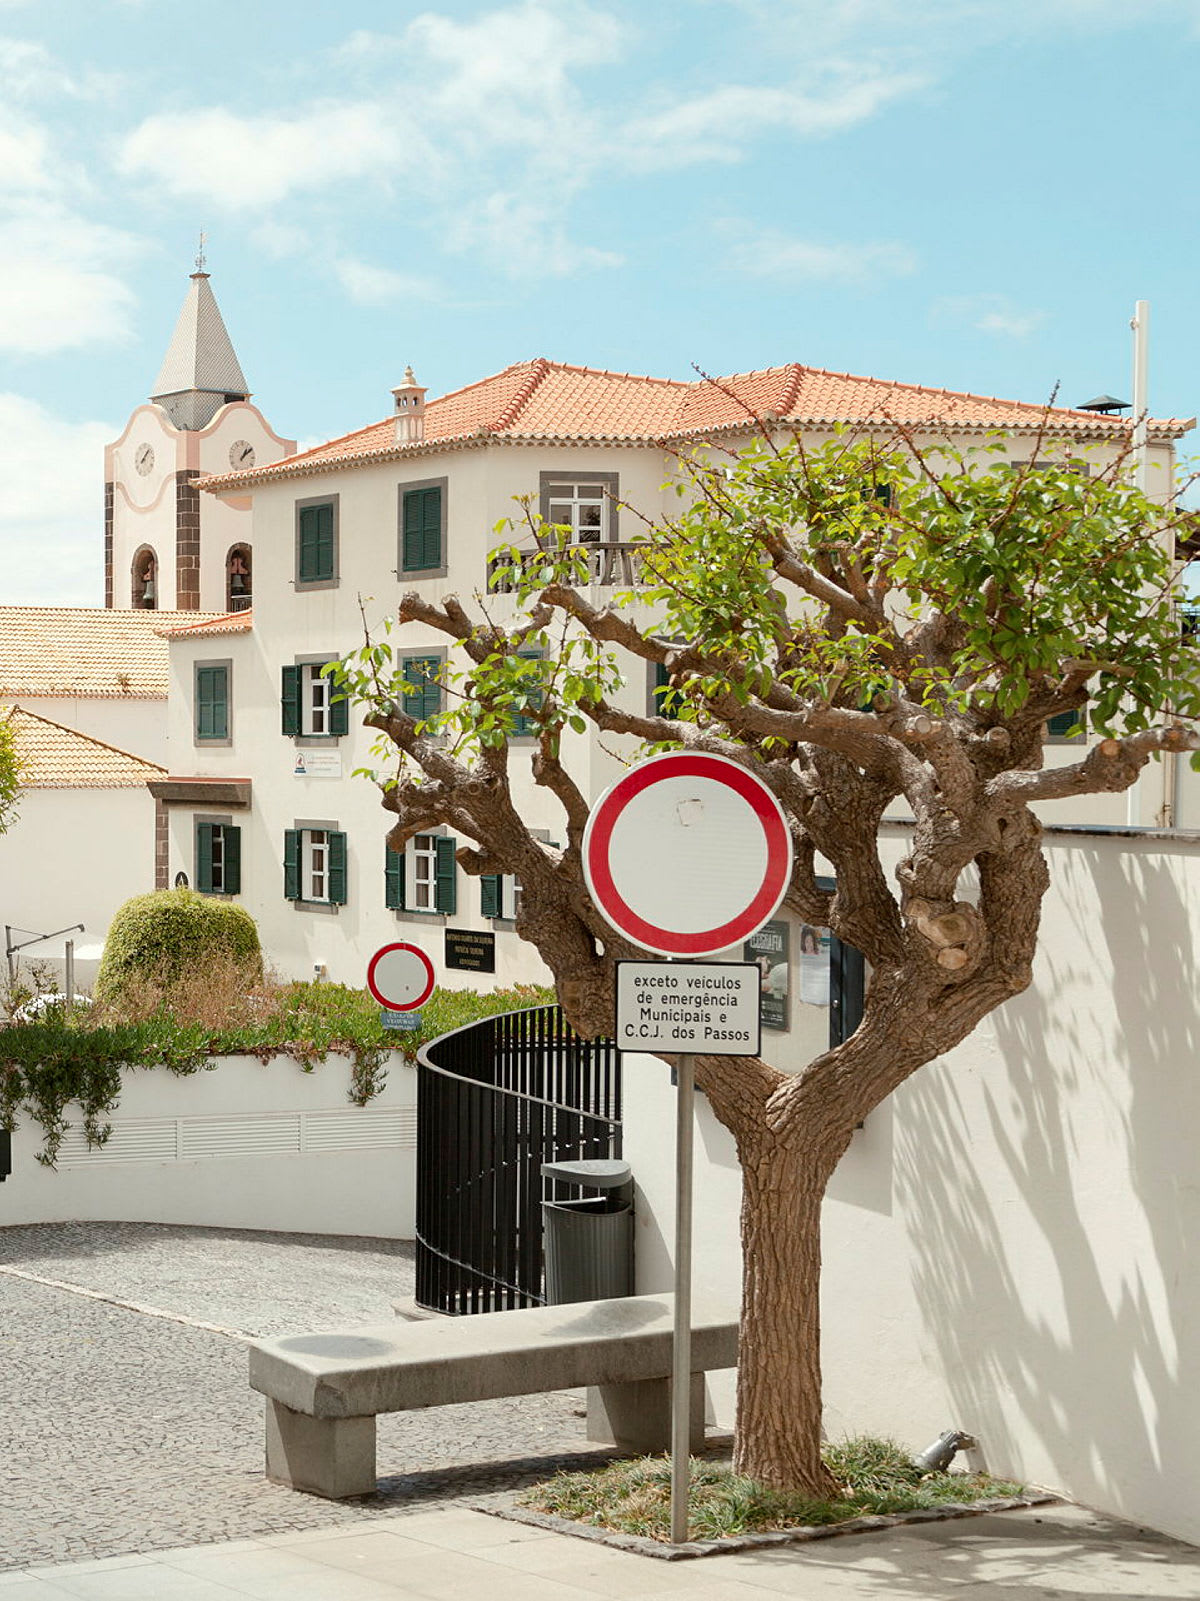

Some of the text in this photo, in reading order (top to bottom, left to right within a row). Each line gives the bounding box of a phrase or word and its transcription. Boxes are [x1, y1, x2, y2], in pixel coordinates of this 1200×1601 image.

[634, 975, 678, 988] exceto
[637, 991, 738, 1008] de emergência
[640, 1008, 727, 1024] Municipais e
[625, 1024, 750, 1041] C.C.J. dos Passos
